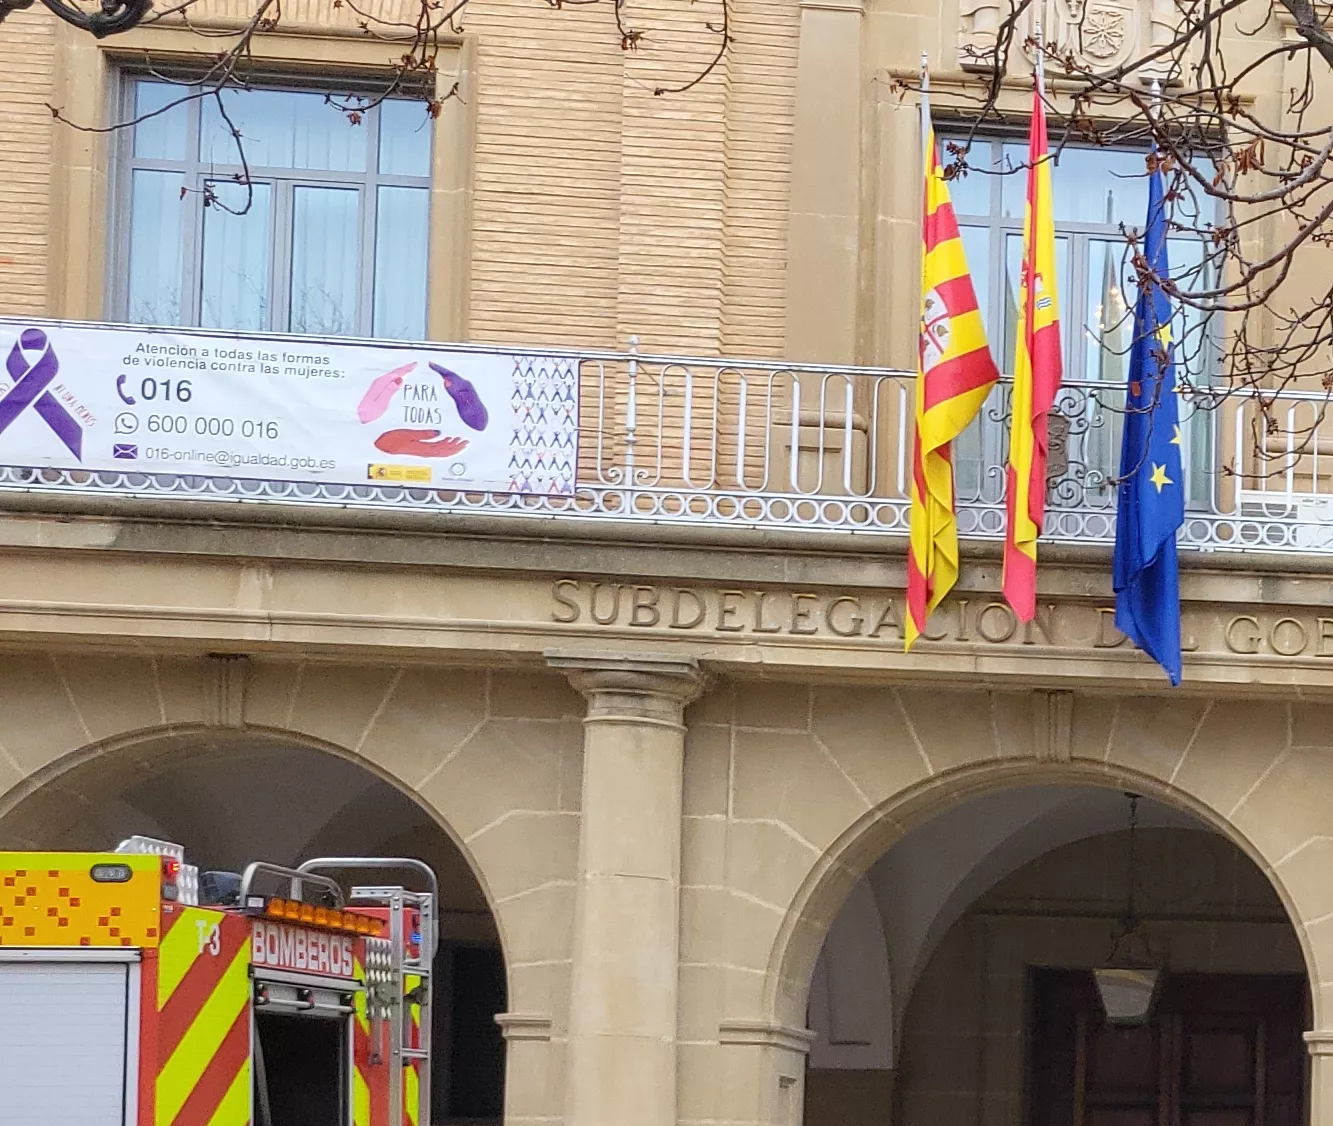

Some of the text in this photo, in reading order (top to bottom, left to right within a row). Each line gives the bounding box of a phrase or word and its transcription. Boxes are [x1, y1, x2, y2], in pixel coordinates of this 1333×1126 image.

[122, 355, 346, 379] de violencia contra las mujeres:
[201, 349, 209, 357] a
[214, 348, 253, 361] todas
[258, 350, 278, 362] las
[282, 352, 331, 365] formas
[141, 377, 193, 403] 016
[403, 384, 438, 402] PARA
[147, 414, 279, 439] 600 000 016
[403, 405, 442, 425] TODAS
[145, 447, 336, 470] 016-online@igualdad.gob.es
[252, 921, 354, 976] BOMBEROS
